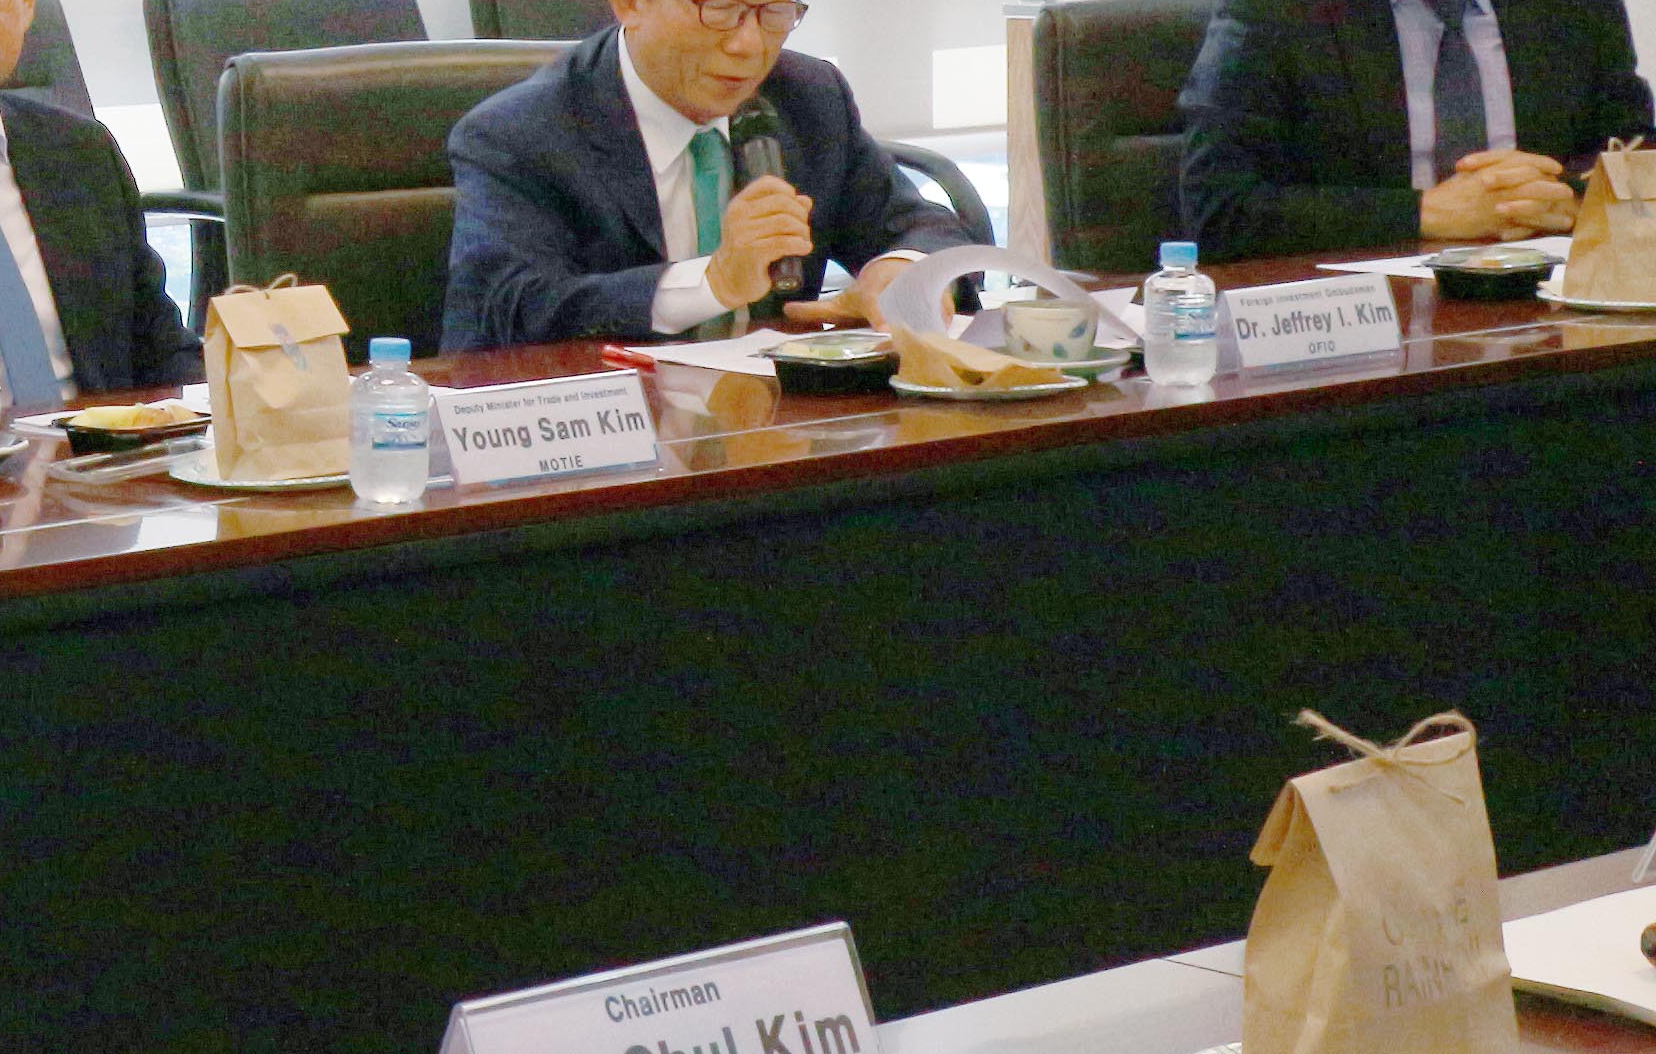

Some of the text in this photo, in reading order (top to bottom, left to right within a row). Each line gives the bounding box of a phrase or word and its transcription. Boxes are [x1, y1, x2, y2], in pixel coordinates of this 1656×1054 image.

[1235, 317, 1267, 340] Dr.
[1271, 310, 1333, 337] Jeffrey
[1355, 302, 1393, 325] Kim
[453, 386, 628, 416] Deputy Minister for Trade and Investment
[453, 408, 646, 452] Young Sam Kim
[538, 454, 584, 473] MOTIE
[604, 981, 723, 1024] Chairman
[755, 1009, 861, 1054] Kim
